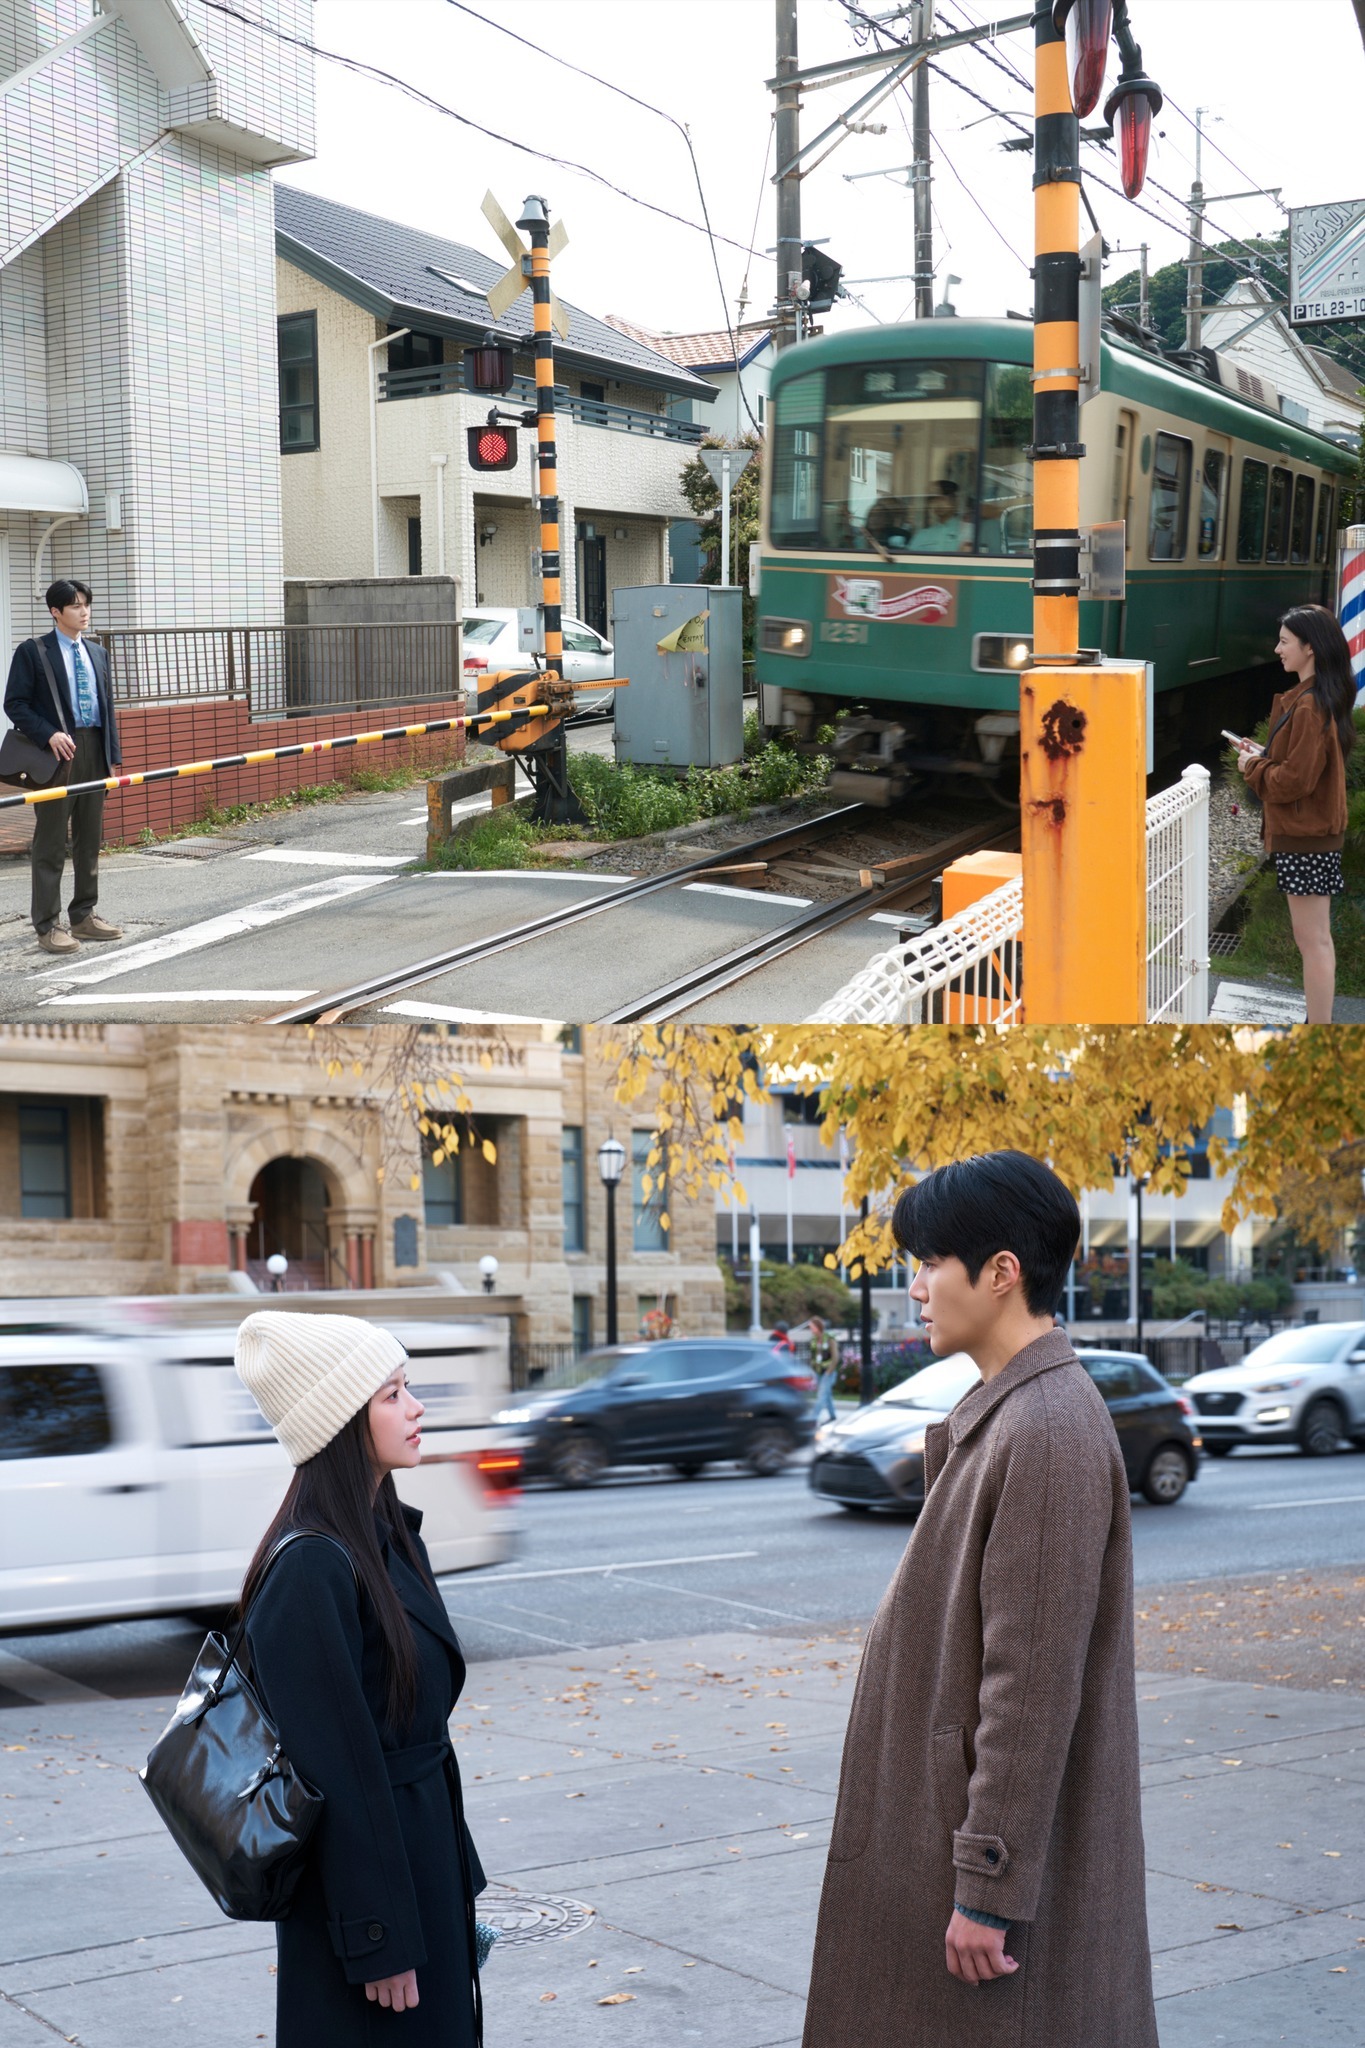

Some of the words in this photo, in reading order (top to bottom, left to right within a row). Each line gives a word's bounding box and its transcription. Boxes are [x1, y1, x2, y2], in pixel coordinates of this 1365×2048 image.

[1291, 232, 1326, 259] HAIR
[1314, 203, 1353, 236] SALON
[1308, 302, 1328, 318] TEL
